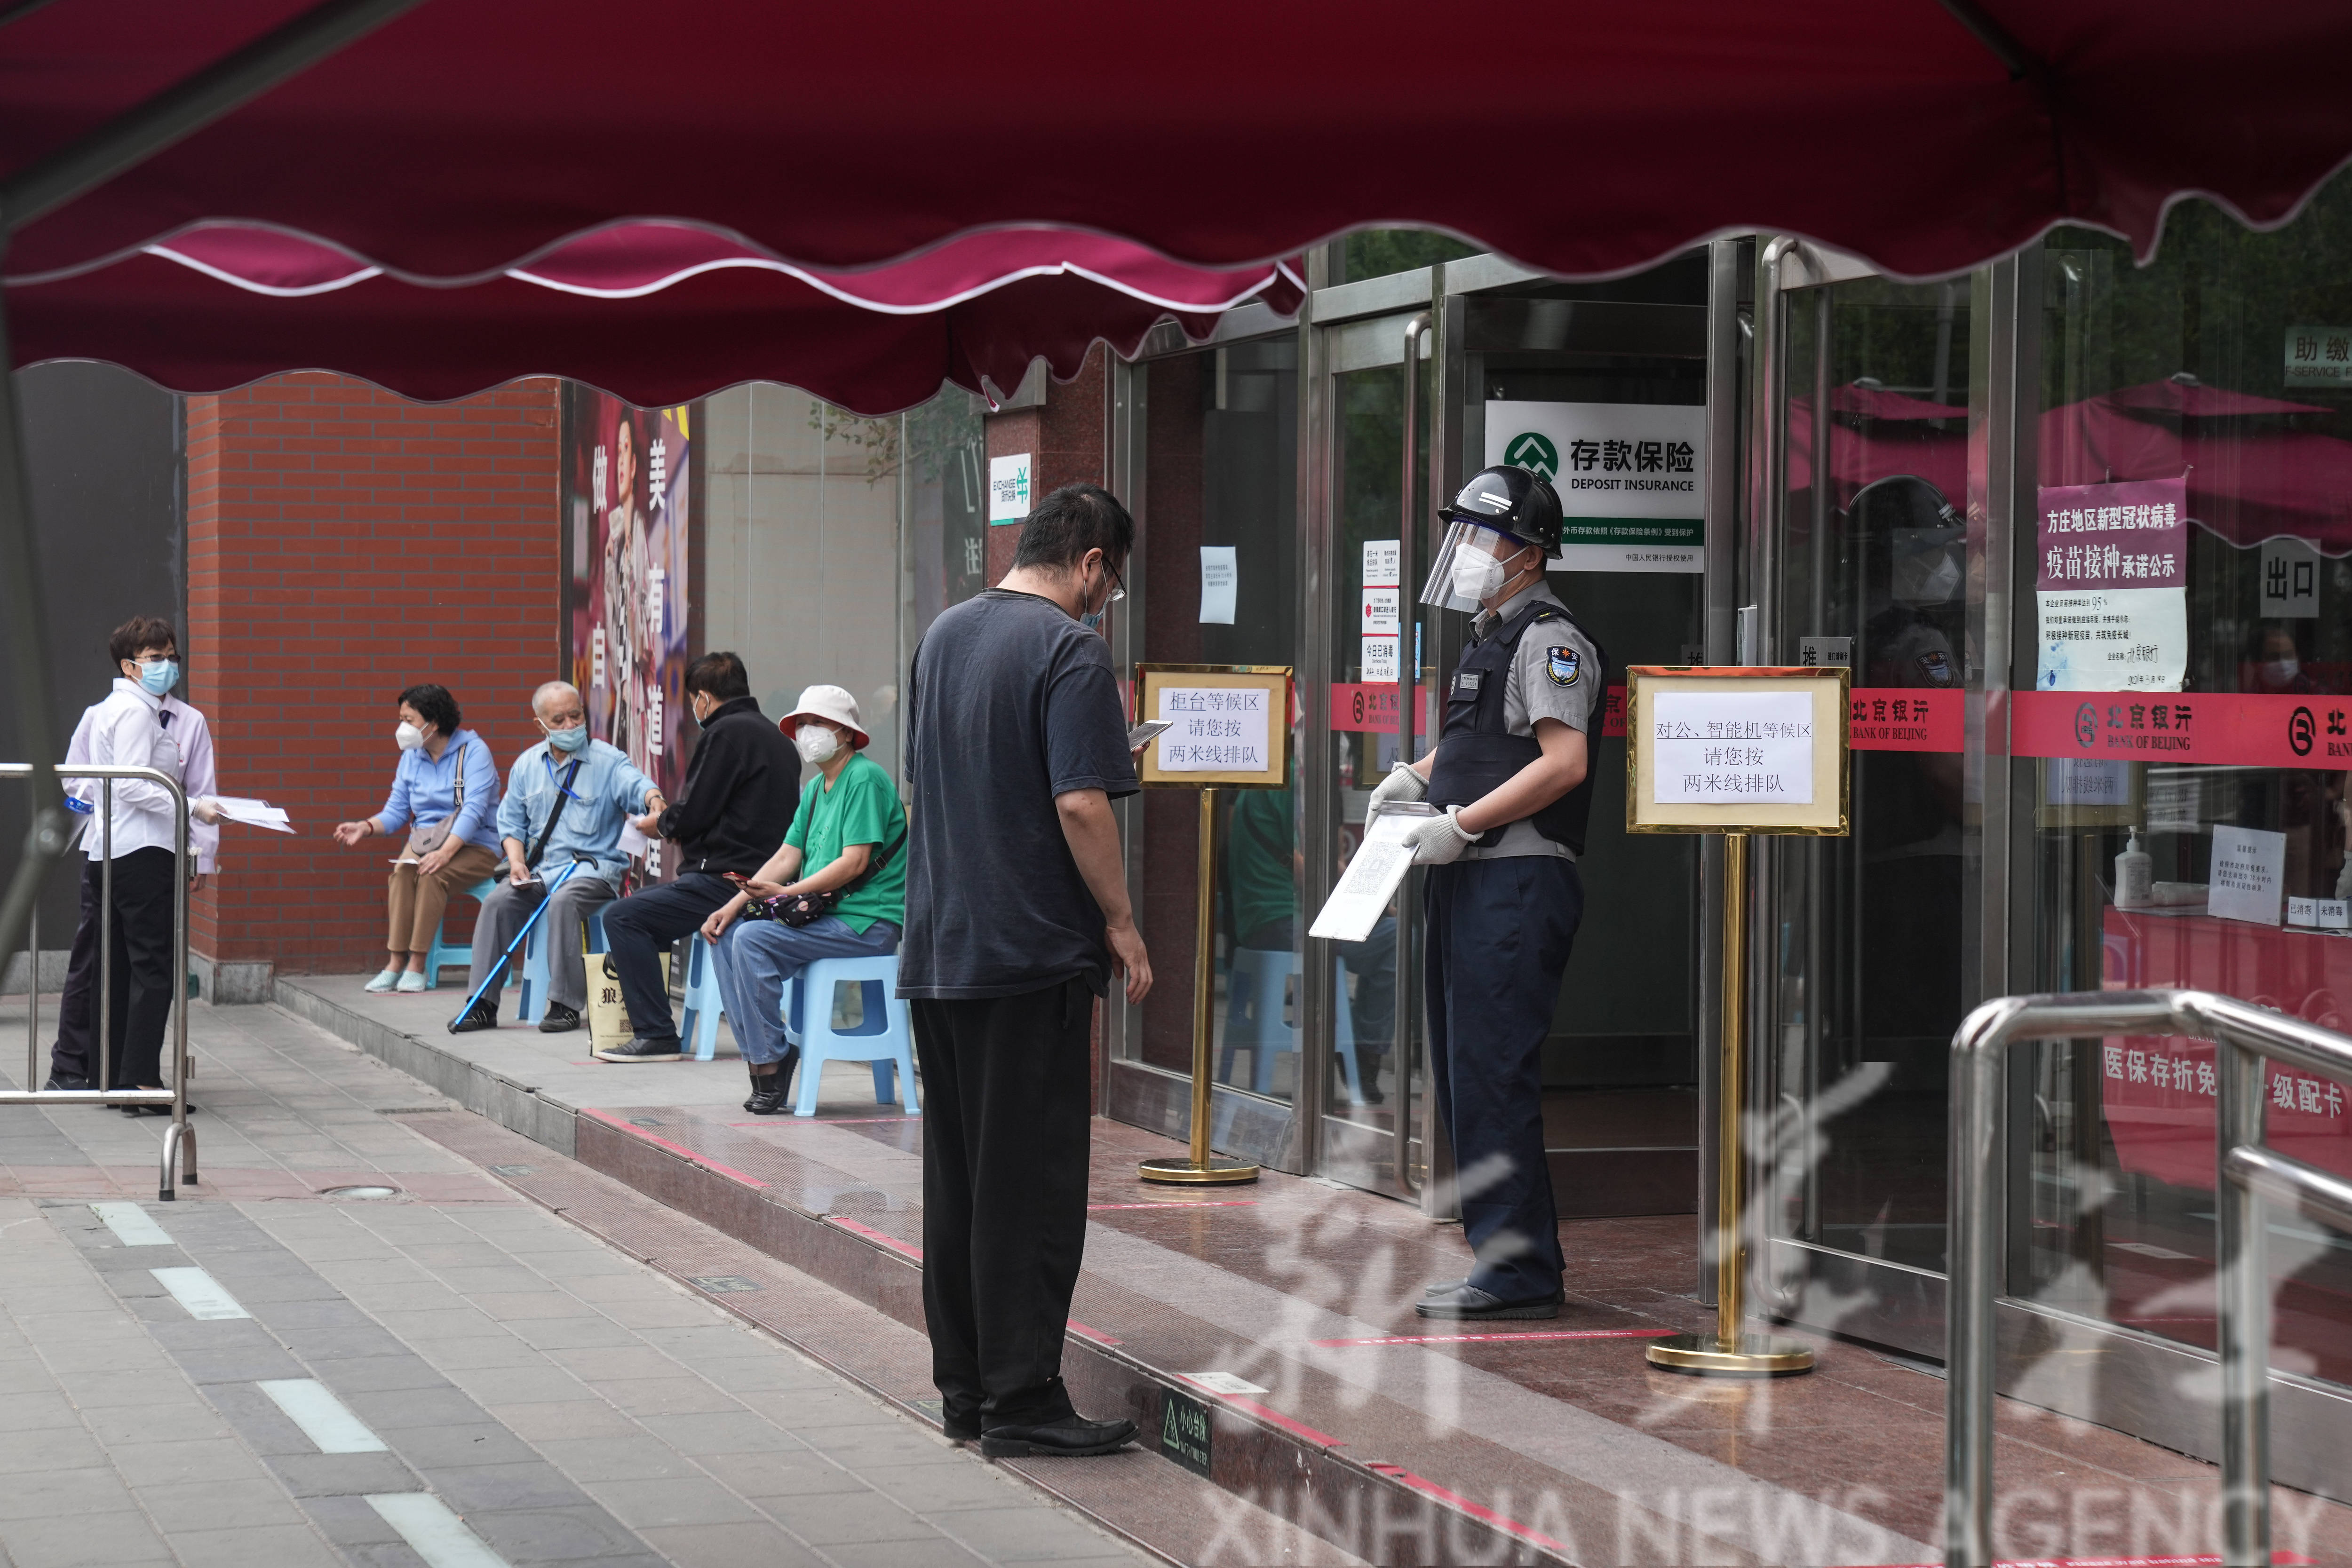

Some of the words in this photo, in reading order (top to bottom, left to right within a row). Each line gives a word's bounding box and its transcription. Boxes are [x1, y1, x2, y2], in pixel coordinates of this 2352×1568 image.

[1570, 439, 1695, 473] 存款保险
[993, 479, 1016, 491] EXCHANGE
[1571, 478, 1621, 490] DEPOSIT
[1624, 479, 1694, 491] INSURANCE
[2047, 502, 2177, 534] 方庄地区新型冠状病毒
[1561, 525, 1694, 537] 外币存款依照《存款保险条例》受到保护
[1625, 554, 1694, 562] 中国人民银行授权使用
[2046, 544, 2176, 580] 疫苗接种承诺公示
[2266, 557, 2313, 601] 出口
[1367, 644, 1393, 657] 今日已消毒
[1169, 692, 1259, 711] 柜台等候区
[1852, 698, 1929, 724] 北京银行
[1368, 714, 1382, 724] BANK
[1382, 715, 1389, 724] OF
[2107, 703, 2192, 732] 北京银行
[2327, 707, 2347, 736] 北
[1188, 718, 1241, 737] 请您按
[1656, 721, 1812, 739] 对公、智能机等候区
[1853, 727, 1876, 739] BANK
[1878, 728, 1890, 739] OF
[1892, 728, 1927, 741] BEIJING
[2107, 735, 2134, 748] BANK
[2136, 736, 2150, 749] OF
[2151, 736, 2190, 751] BEIJING
[1169, 744, 1259, 764] 两米线排队
[1703, 747, 1764, 766] 请您按
[1683, 774, 1785, 793] 两米线排队
[2237, 845, 2257, 855] 温馨提示
[2290, 904, 2312, 916] 已消毒
[2320, 905, 2343, 917] 未消毒
[1180, 1404, 1207, 1443] 小心台阶
[1180, 1440, 1191, 1457] WATCH
[1191, 1445, 1200, 1462] YOUR
